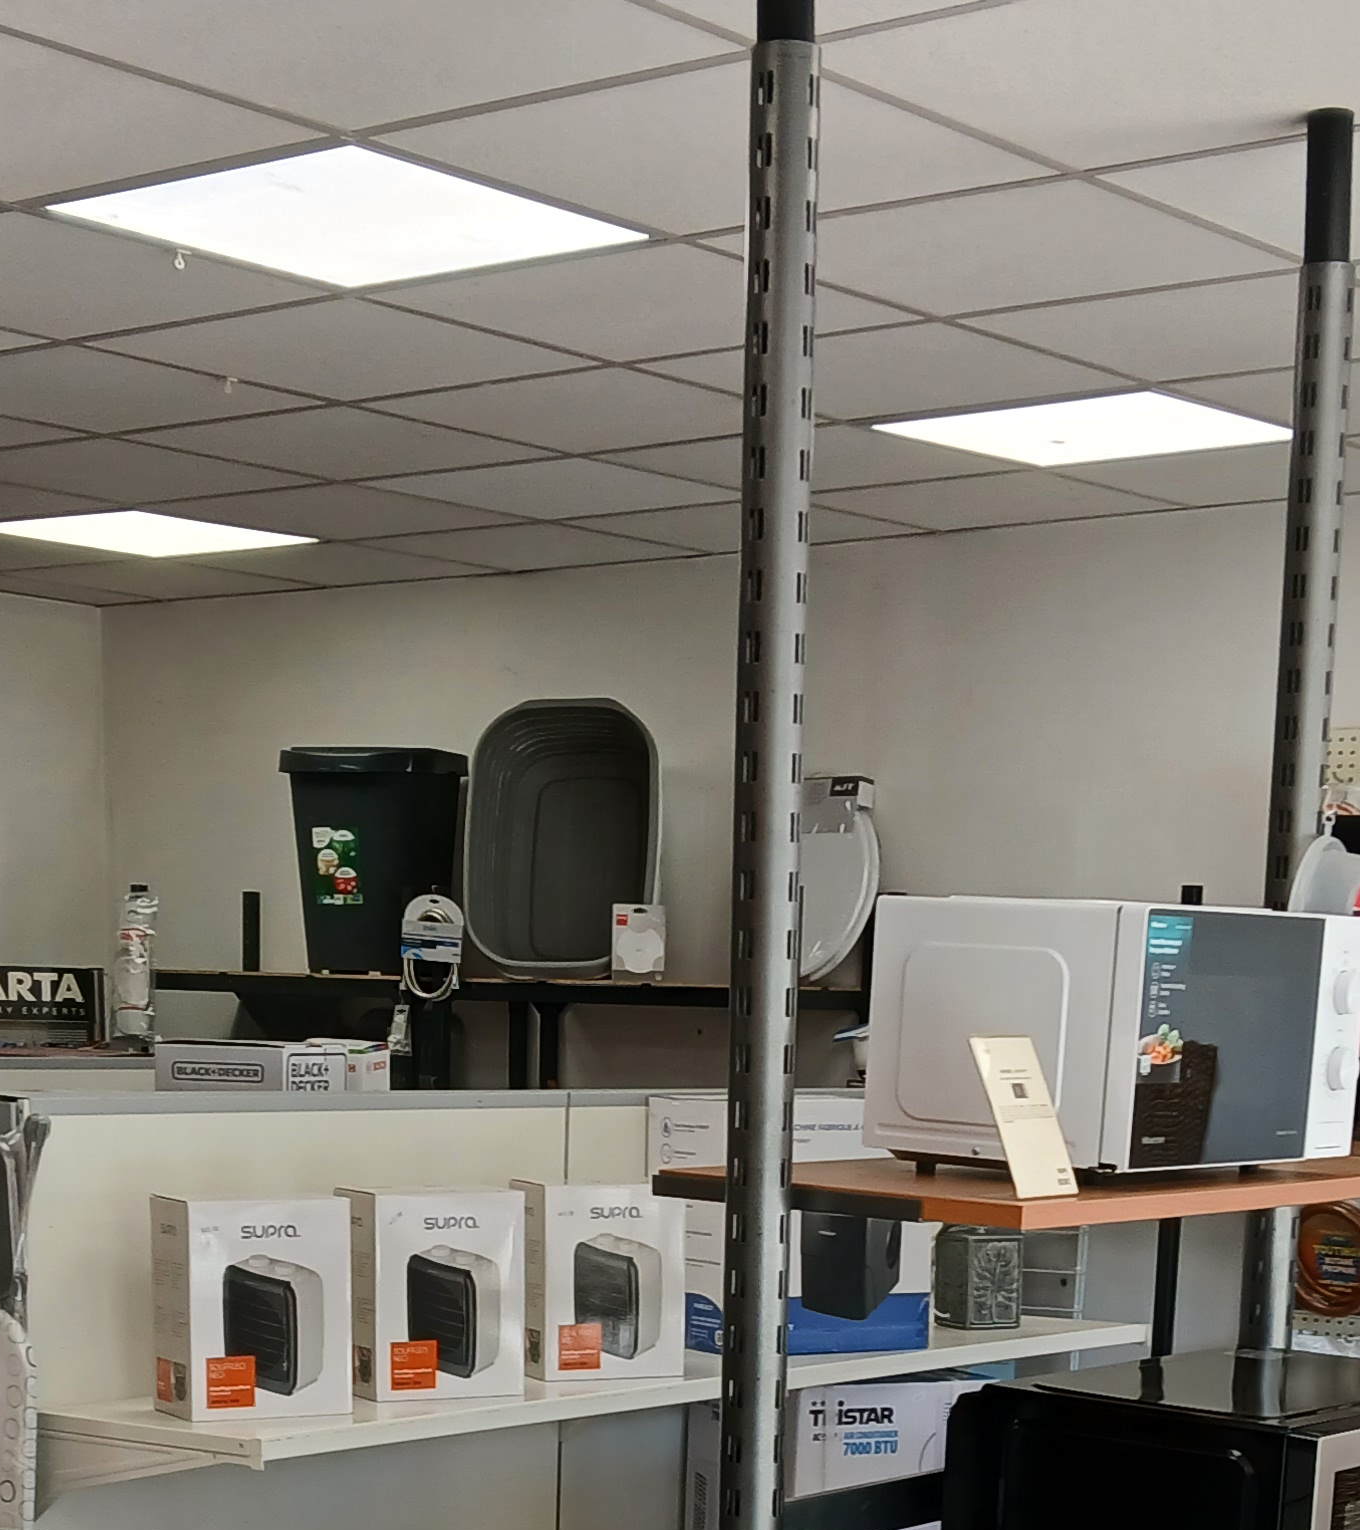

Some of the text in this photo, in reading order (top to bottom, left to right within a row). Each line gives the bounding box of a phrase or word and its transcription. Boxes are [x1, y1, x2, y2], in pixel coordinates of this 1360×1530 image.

[21, 1007, 86, 1016] EXPERTS
[843, 1440, 899, 1456] 7000 BTU
